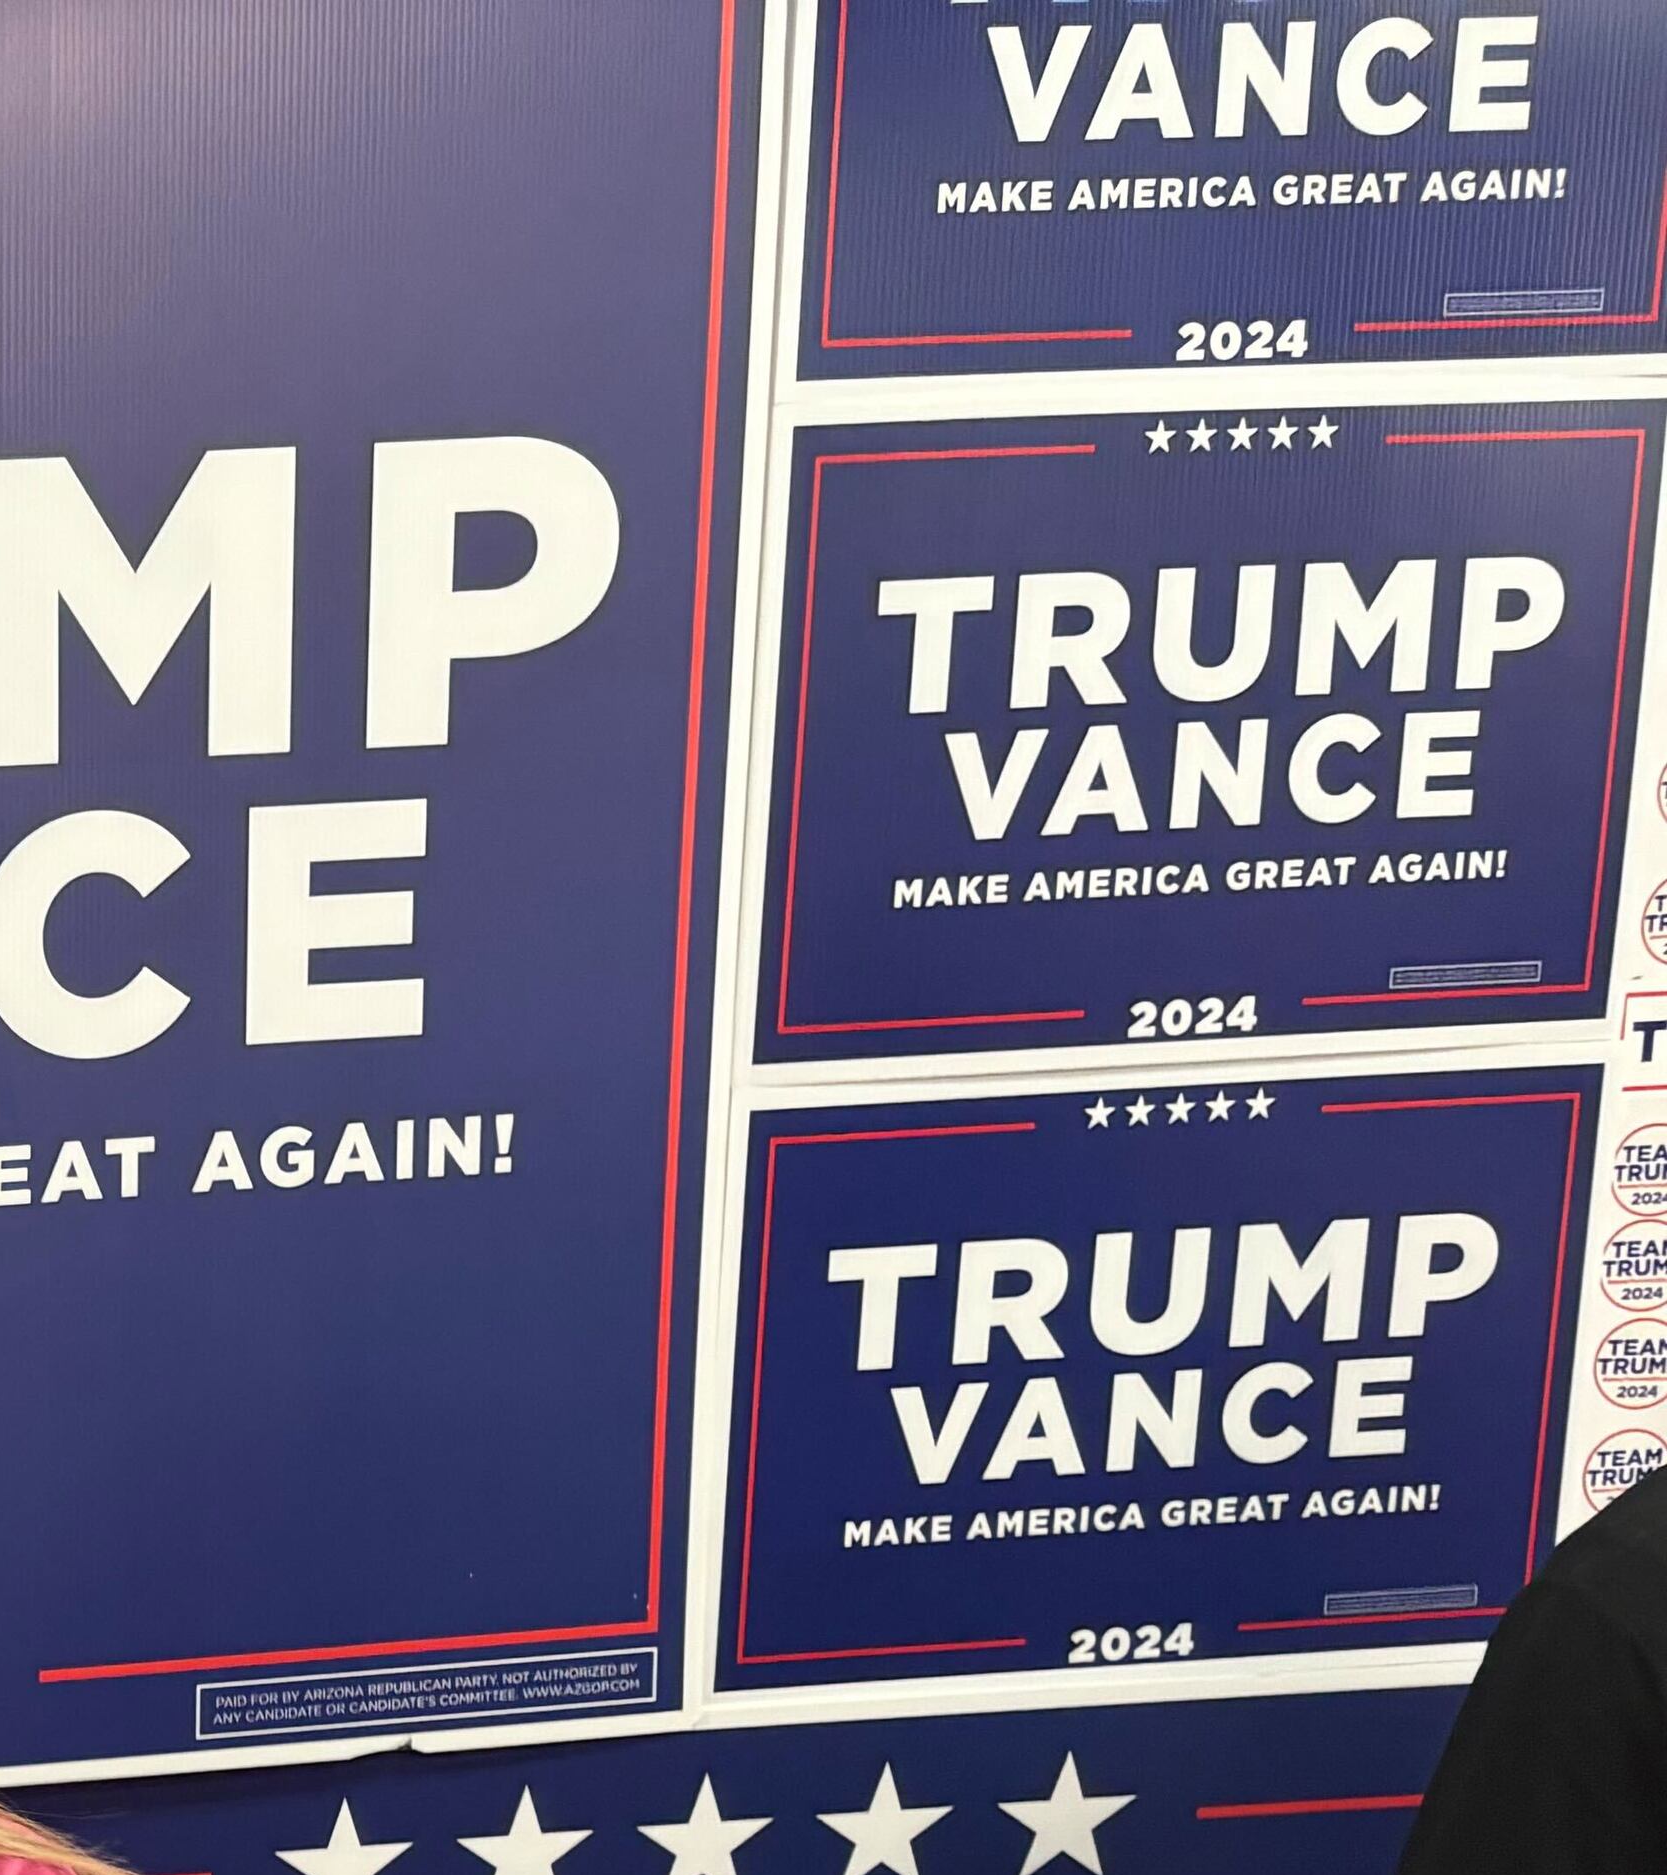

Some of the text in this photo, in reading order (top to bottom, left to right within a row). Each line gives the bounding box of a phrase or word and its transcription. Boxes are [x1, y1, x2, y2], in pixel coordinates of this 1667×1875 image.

[987, 15, 1539, 143] VANCE
[937, 167, 1567, 214] MAKE AMERICA GREAT AGAIN!
[1175, 319, 1309, 362] 2024
[877, 556, 1565, 715] TRUMP
[944, 710, 1481, 841] VANCE
[893, 849, 1508, 909] MAKE AMERICA GREAT AGAIN!
[1127, 995, 1259, 1039] 2024
[192, 1113, 514, 1193] AGAIN!
[827, 1212, 1499, 1371] TRUMP
[1621, 1287, 1664, 1300] 2024
[1616, 1385, 1659, 1399] 2024
[890, 1356, 1413, 1485] VANCE
[1597, 1448, 1663, 1467] TEAM
[843, 1484, 1441, 1548] MAKE AMERICA GREAT AGAIN!
[1068, 1622, 1195, 1664] 2024
[216, 1696, 247, 1709] PAID
[251, 1692, 278, 1706] FOR
[304, 1684, 364, 1701] ARIZONA
[368, 1677, 451, 1696] REPUBLICAN
[502, 1671, 529, 1683] NOT
[533, 1664, 617, 1681] AUTHORIZED
[214, 1712, 242, 1725] ANY
[245, 1706, 322, 1723] CANDIDATE
[325, 1704, 346, 1716] OR
